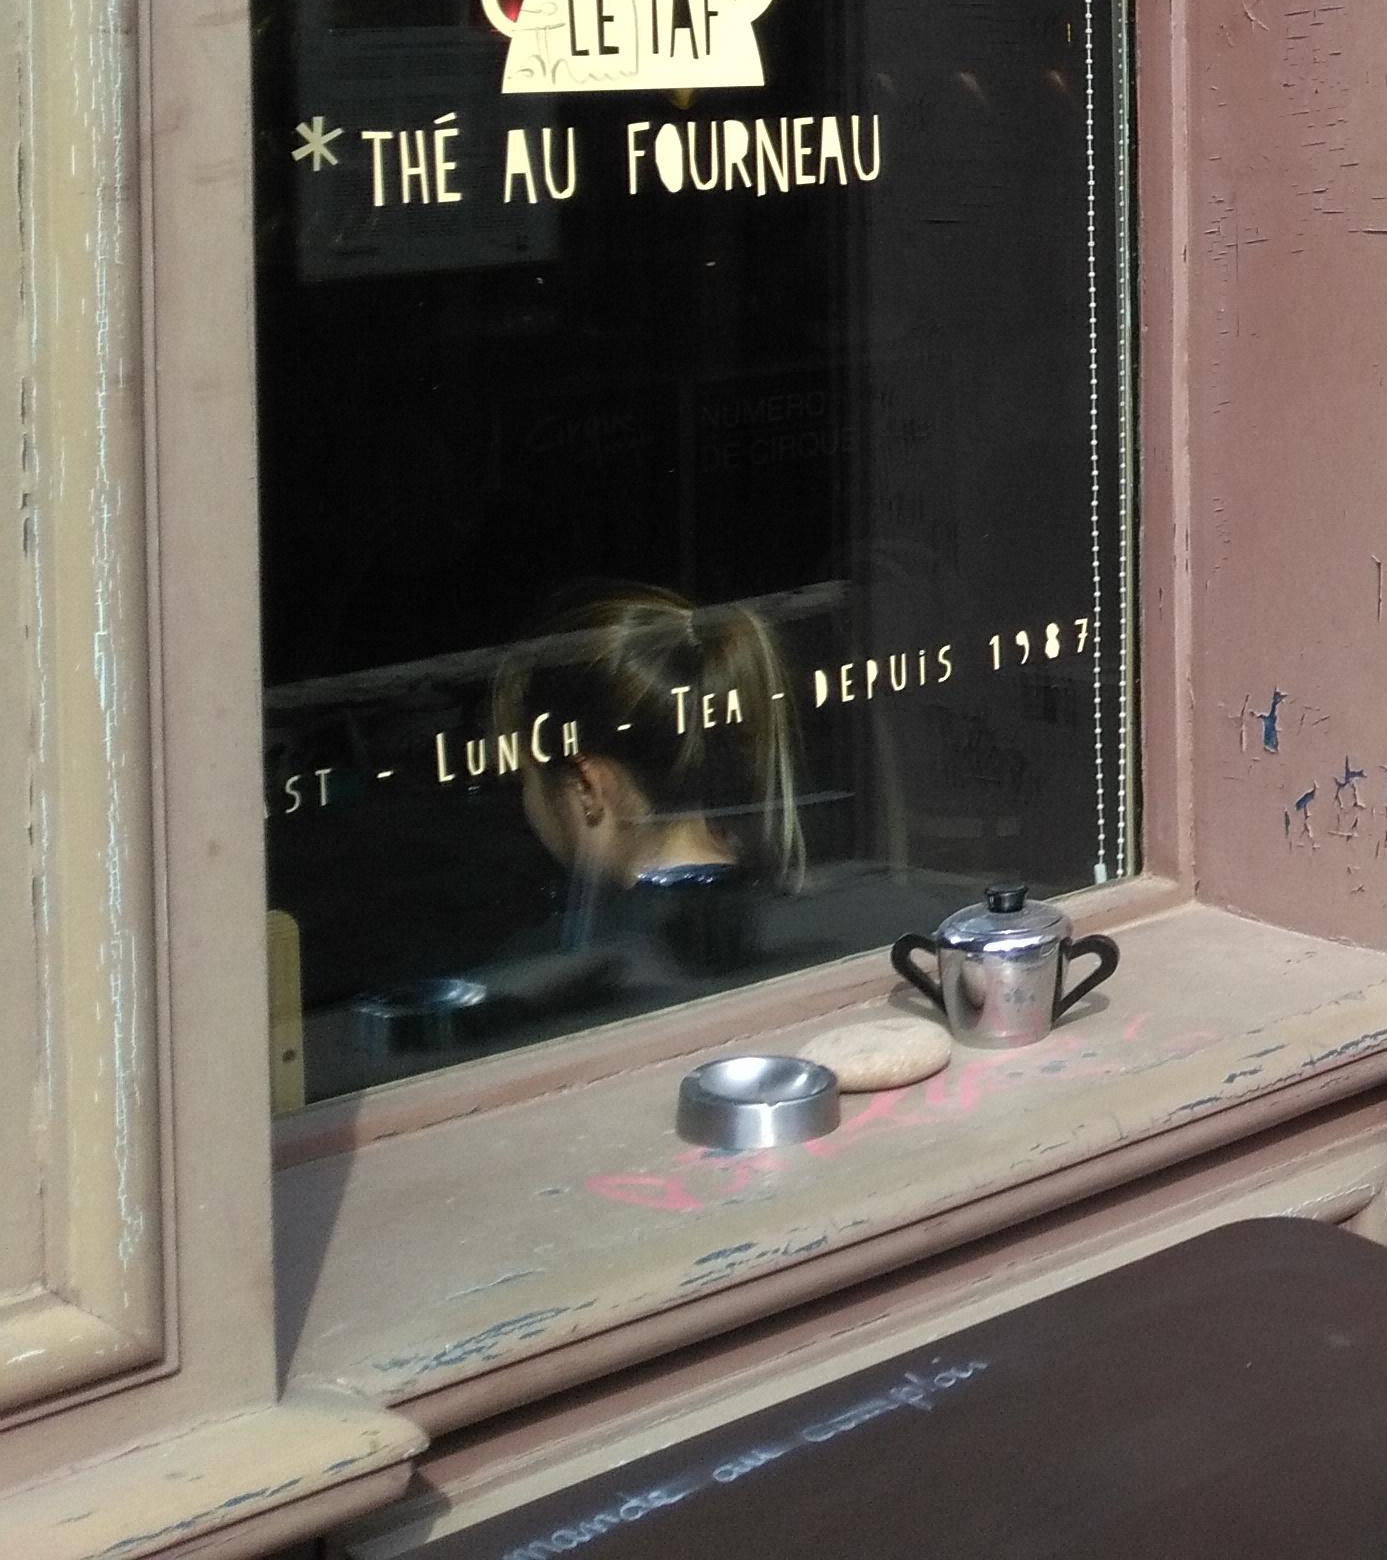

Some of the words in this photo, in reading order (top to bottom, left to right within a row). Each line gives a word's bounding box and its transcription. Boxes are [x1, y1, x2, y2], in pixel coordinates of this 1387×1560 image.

[503, 126, 578, 206] AU
[628, 114, 882, 200] FOURNEAU
[989, 618, 1089, 670] 1987
